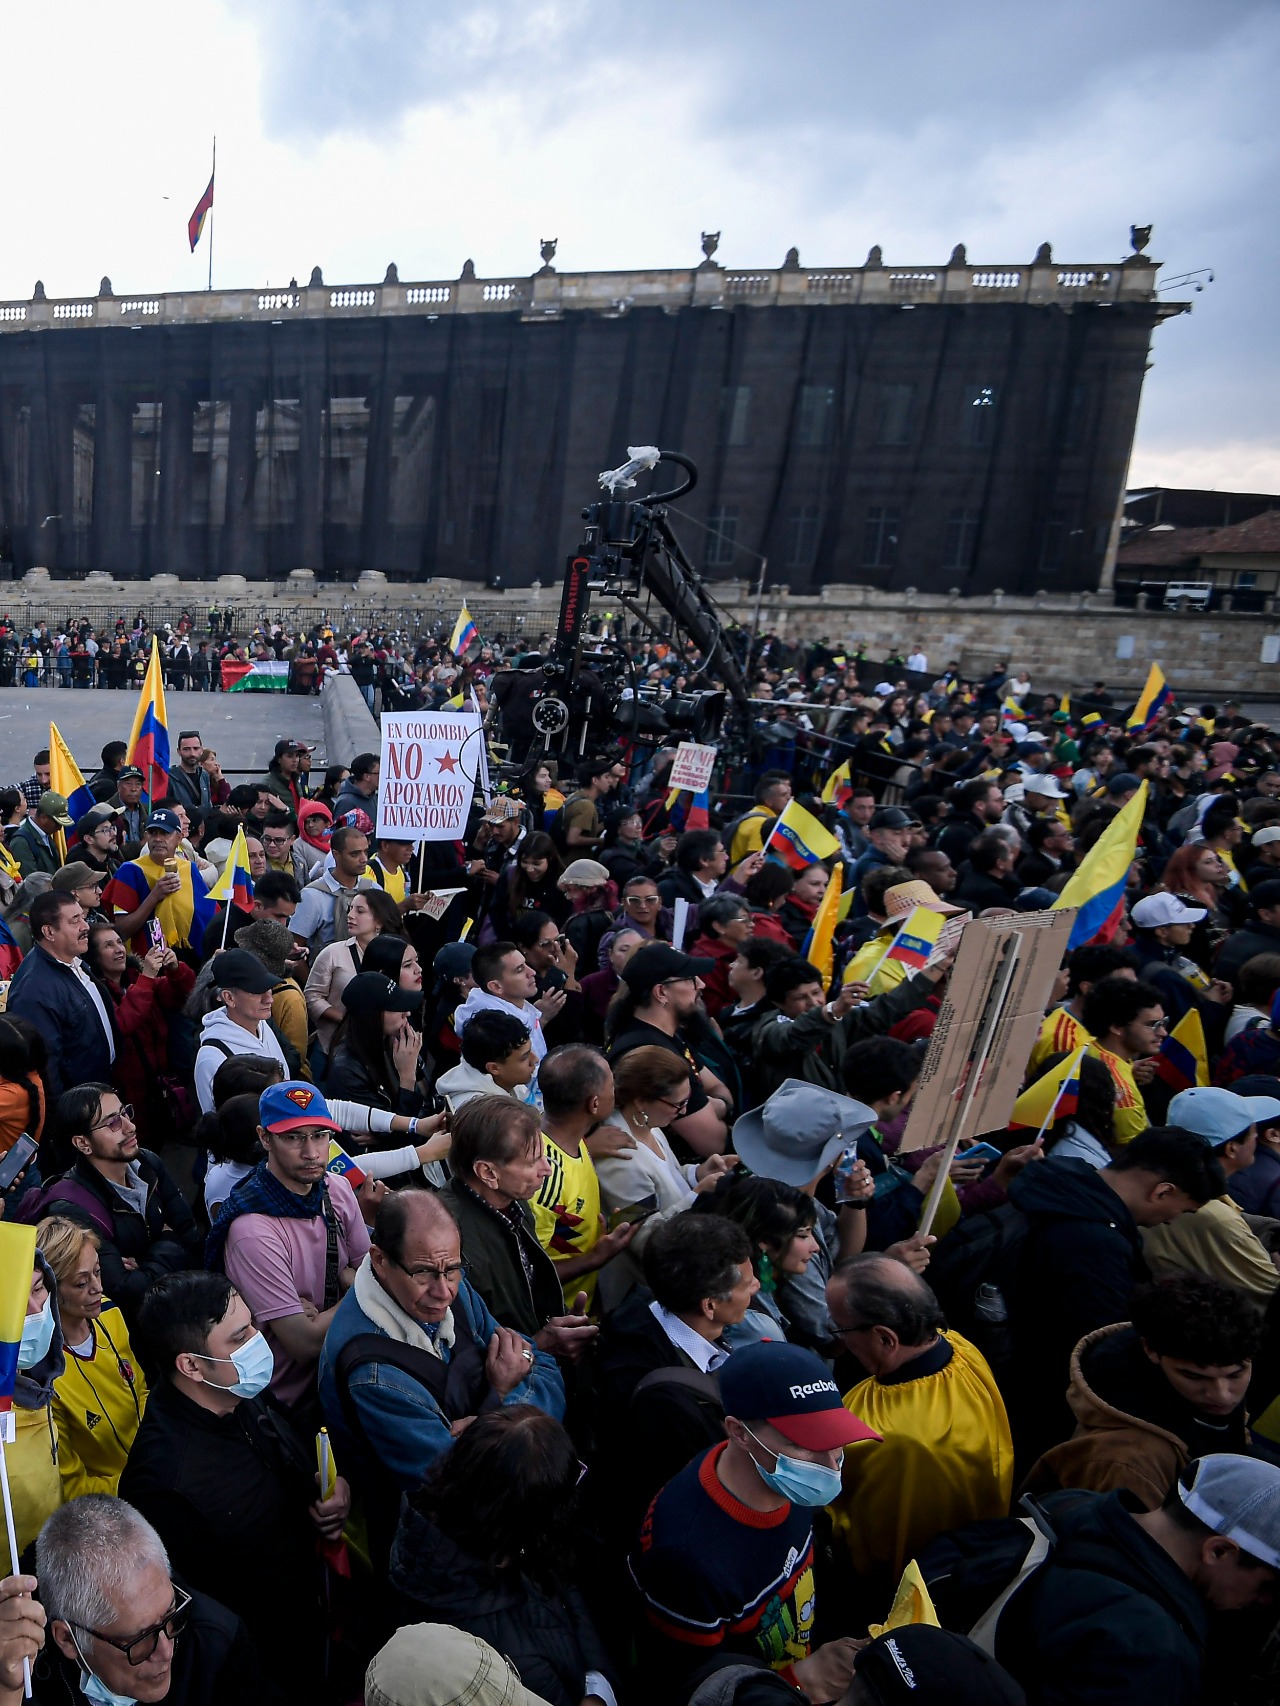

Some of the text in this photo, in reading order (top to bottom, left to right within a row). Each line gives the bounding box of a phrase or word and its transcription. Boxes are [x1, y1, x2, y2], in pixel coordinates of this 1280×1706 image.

[387, 723, 469, 740] EN COLOMBIA
[385, 742, 423, 780] NO
[671, 776, 706, 788] MIEDO
[383, 782, 465, 807] APOYAMOS
[382, 805, 461, 829] INVASIONES
